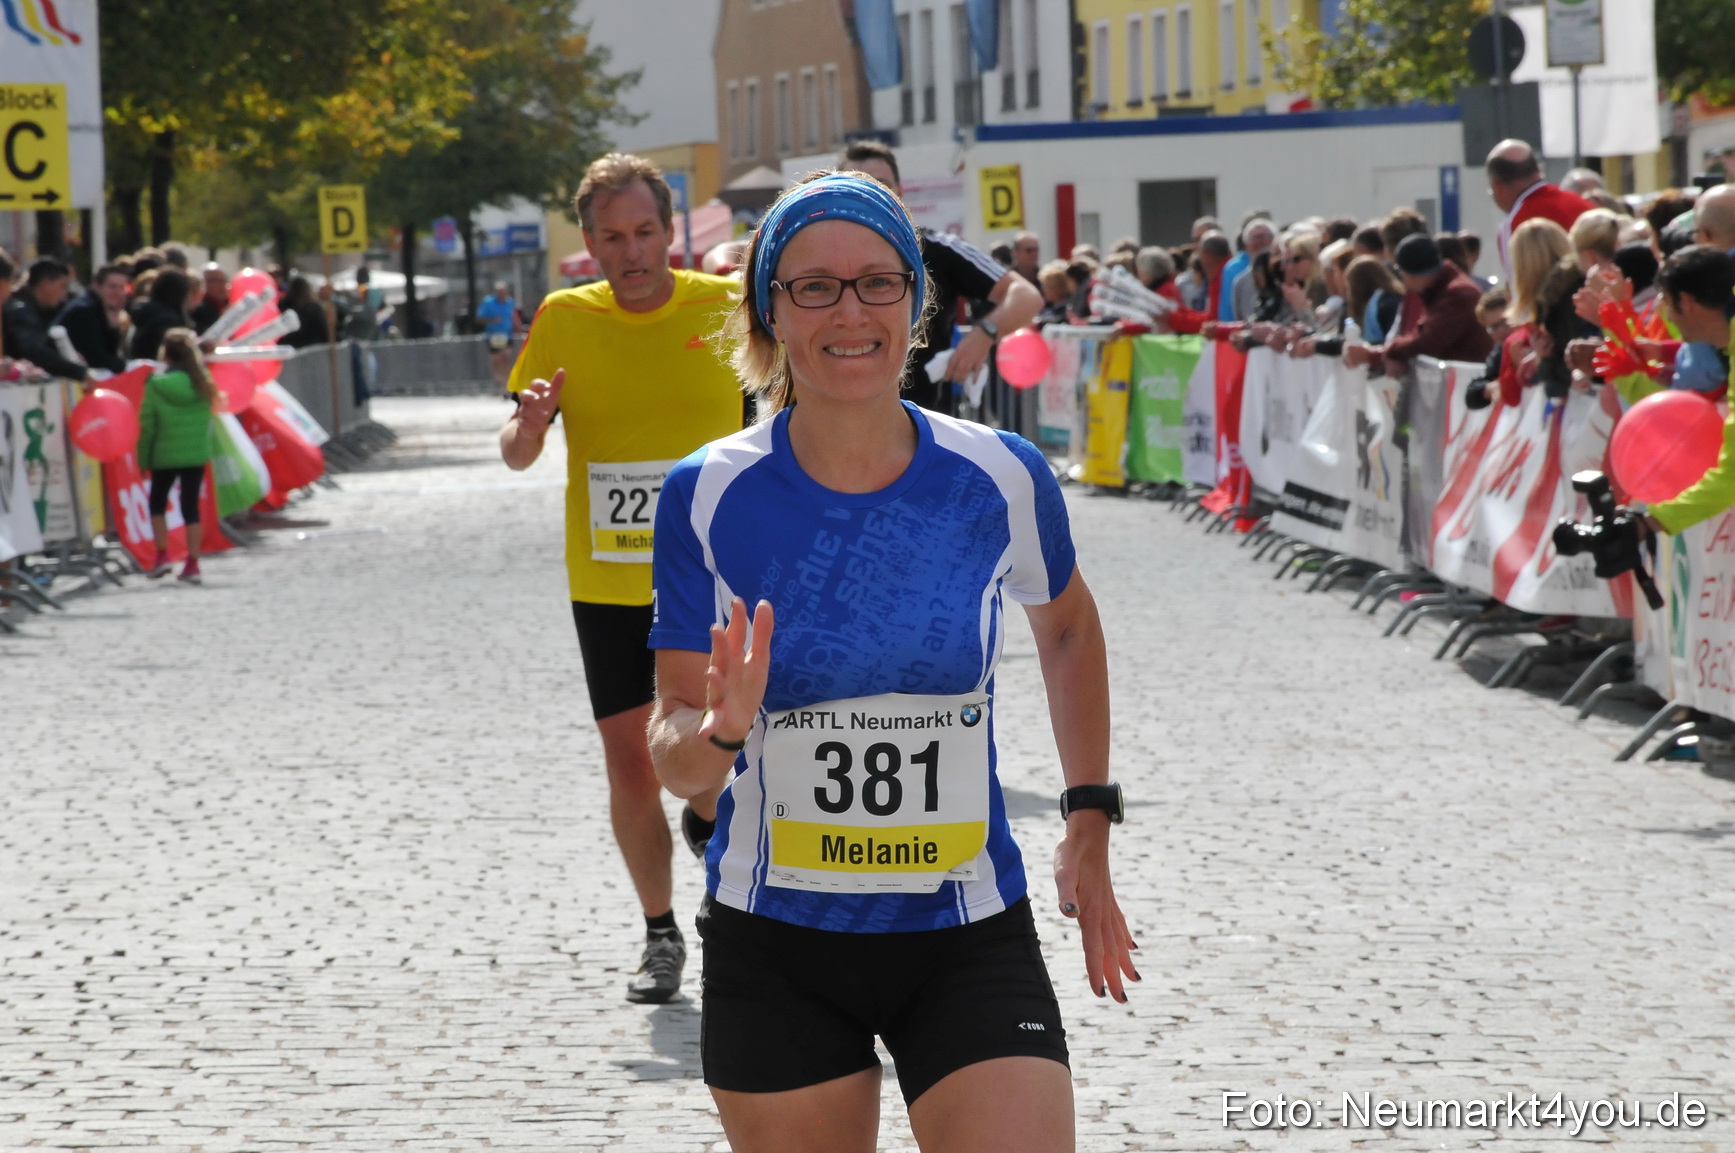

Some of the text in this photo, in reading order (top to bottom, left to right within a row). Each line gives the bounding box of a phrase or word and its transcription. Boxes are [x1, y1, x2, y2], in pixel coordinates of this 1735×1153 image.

[4, 120, 47, 181] C
[991, 185, 1014, 216] D
[332, 206, 355, 238] D
[622, 473, 667, 482] Neumark
[850, 710, 953, 730] Neumarkt
[813, 740, 940, 817] 381
[776, 804, 785, 817] D
[821, 834, 938, 865] Melanie
